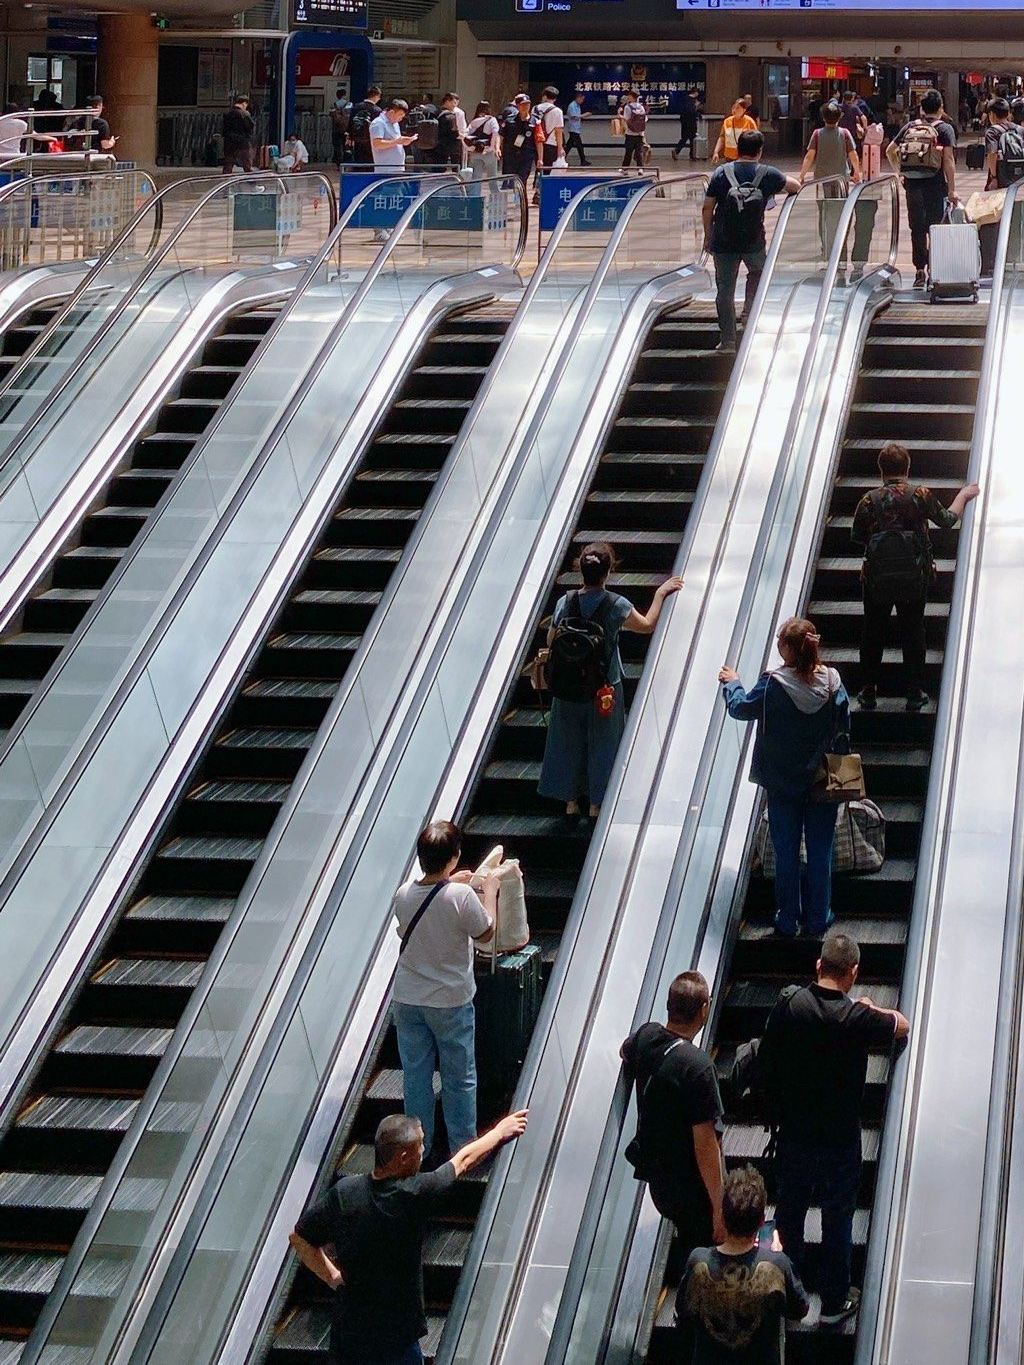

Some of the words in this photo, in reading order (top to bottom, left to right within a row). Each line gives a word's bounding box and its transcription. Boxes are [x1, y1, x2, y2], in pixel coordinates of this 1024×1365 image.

[548, 3, 571, 11] Police
[575, 81, 705, 92] 北京铁路公安处北京西站派出所
